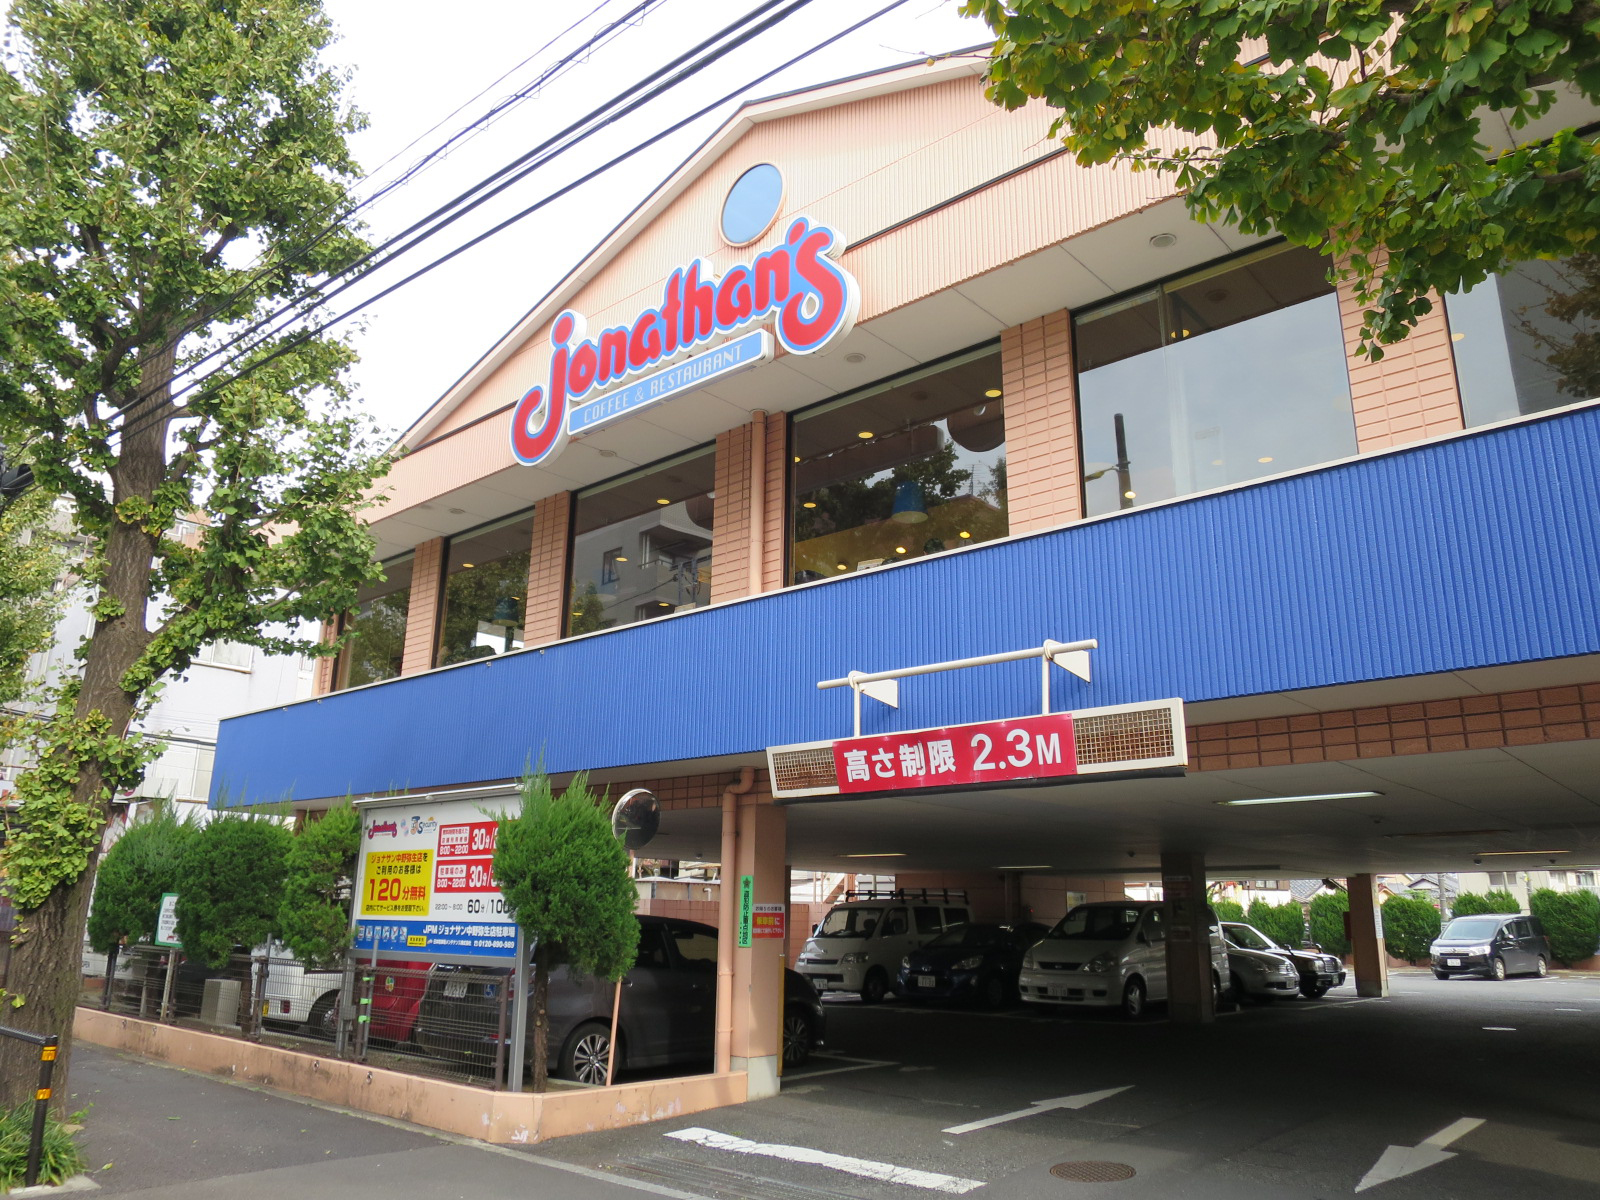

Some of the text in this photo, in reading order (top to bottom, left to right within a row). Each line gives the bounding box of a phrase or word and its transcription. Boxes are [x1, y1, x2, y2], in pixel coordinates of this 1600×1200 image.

[583, 343, 743, 424] COFFEE & RESTAURANT
[843, 728, 1062, 783] 高さ制限 2.3M
[371, 853, 428, 863] ジョナサン中野弥生店を
[376, 864, 422, 875] ご利用のお客様は
[439, 866, 465, 876] 駐車場のみ
[369, 878, 426, 902] 120分無料
[439, 925, 516, 938] ジョナサン中野弥生店駐車場
